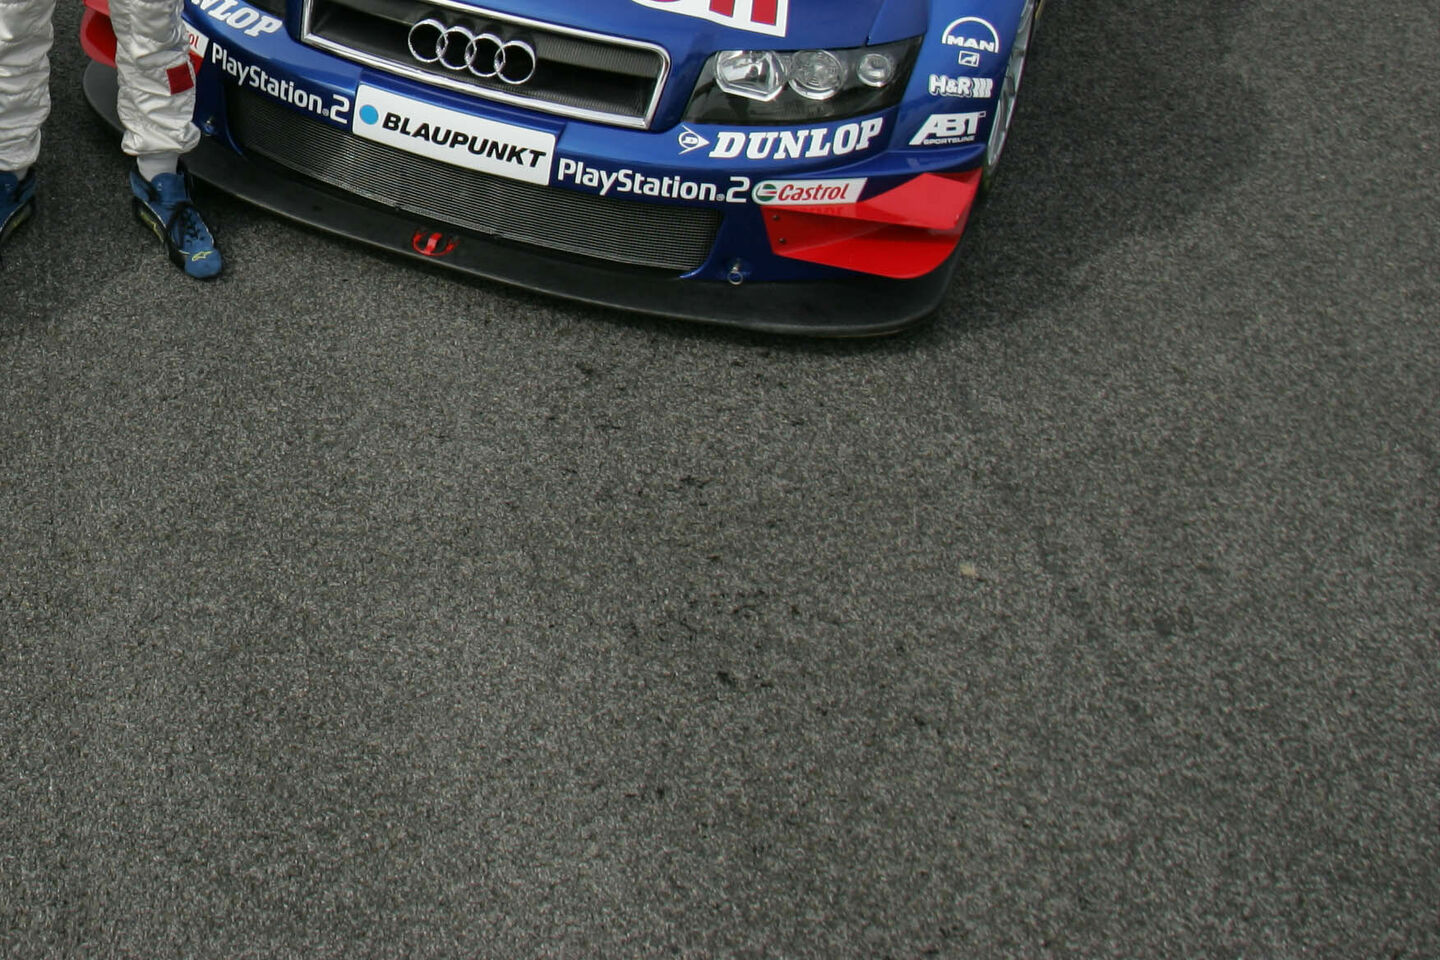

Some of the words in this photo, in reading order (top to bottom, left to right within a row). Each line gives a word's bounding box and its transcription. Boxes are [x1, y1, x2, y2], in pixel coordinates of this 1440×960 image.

[947, 35, 995, 53] MAN
[382, 111, 547, 169] BLAUPUNKT
[708, 117, 884, 160] DUNLOP
[909, 111, 986, 145] ABT
[777, 182, 851, 202] Castrol
